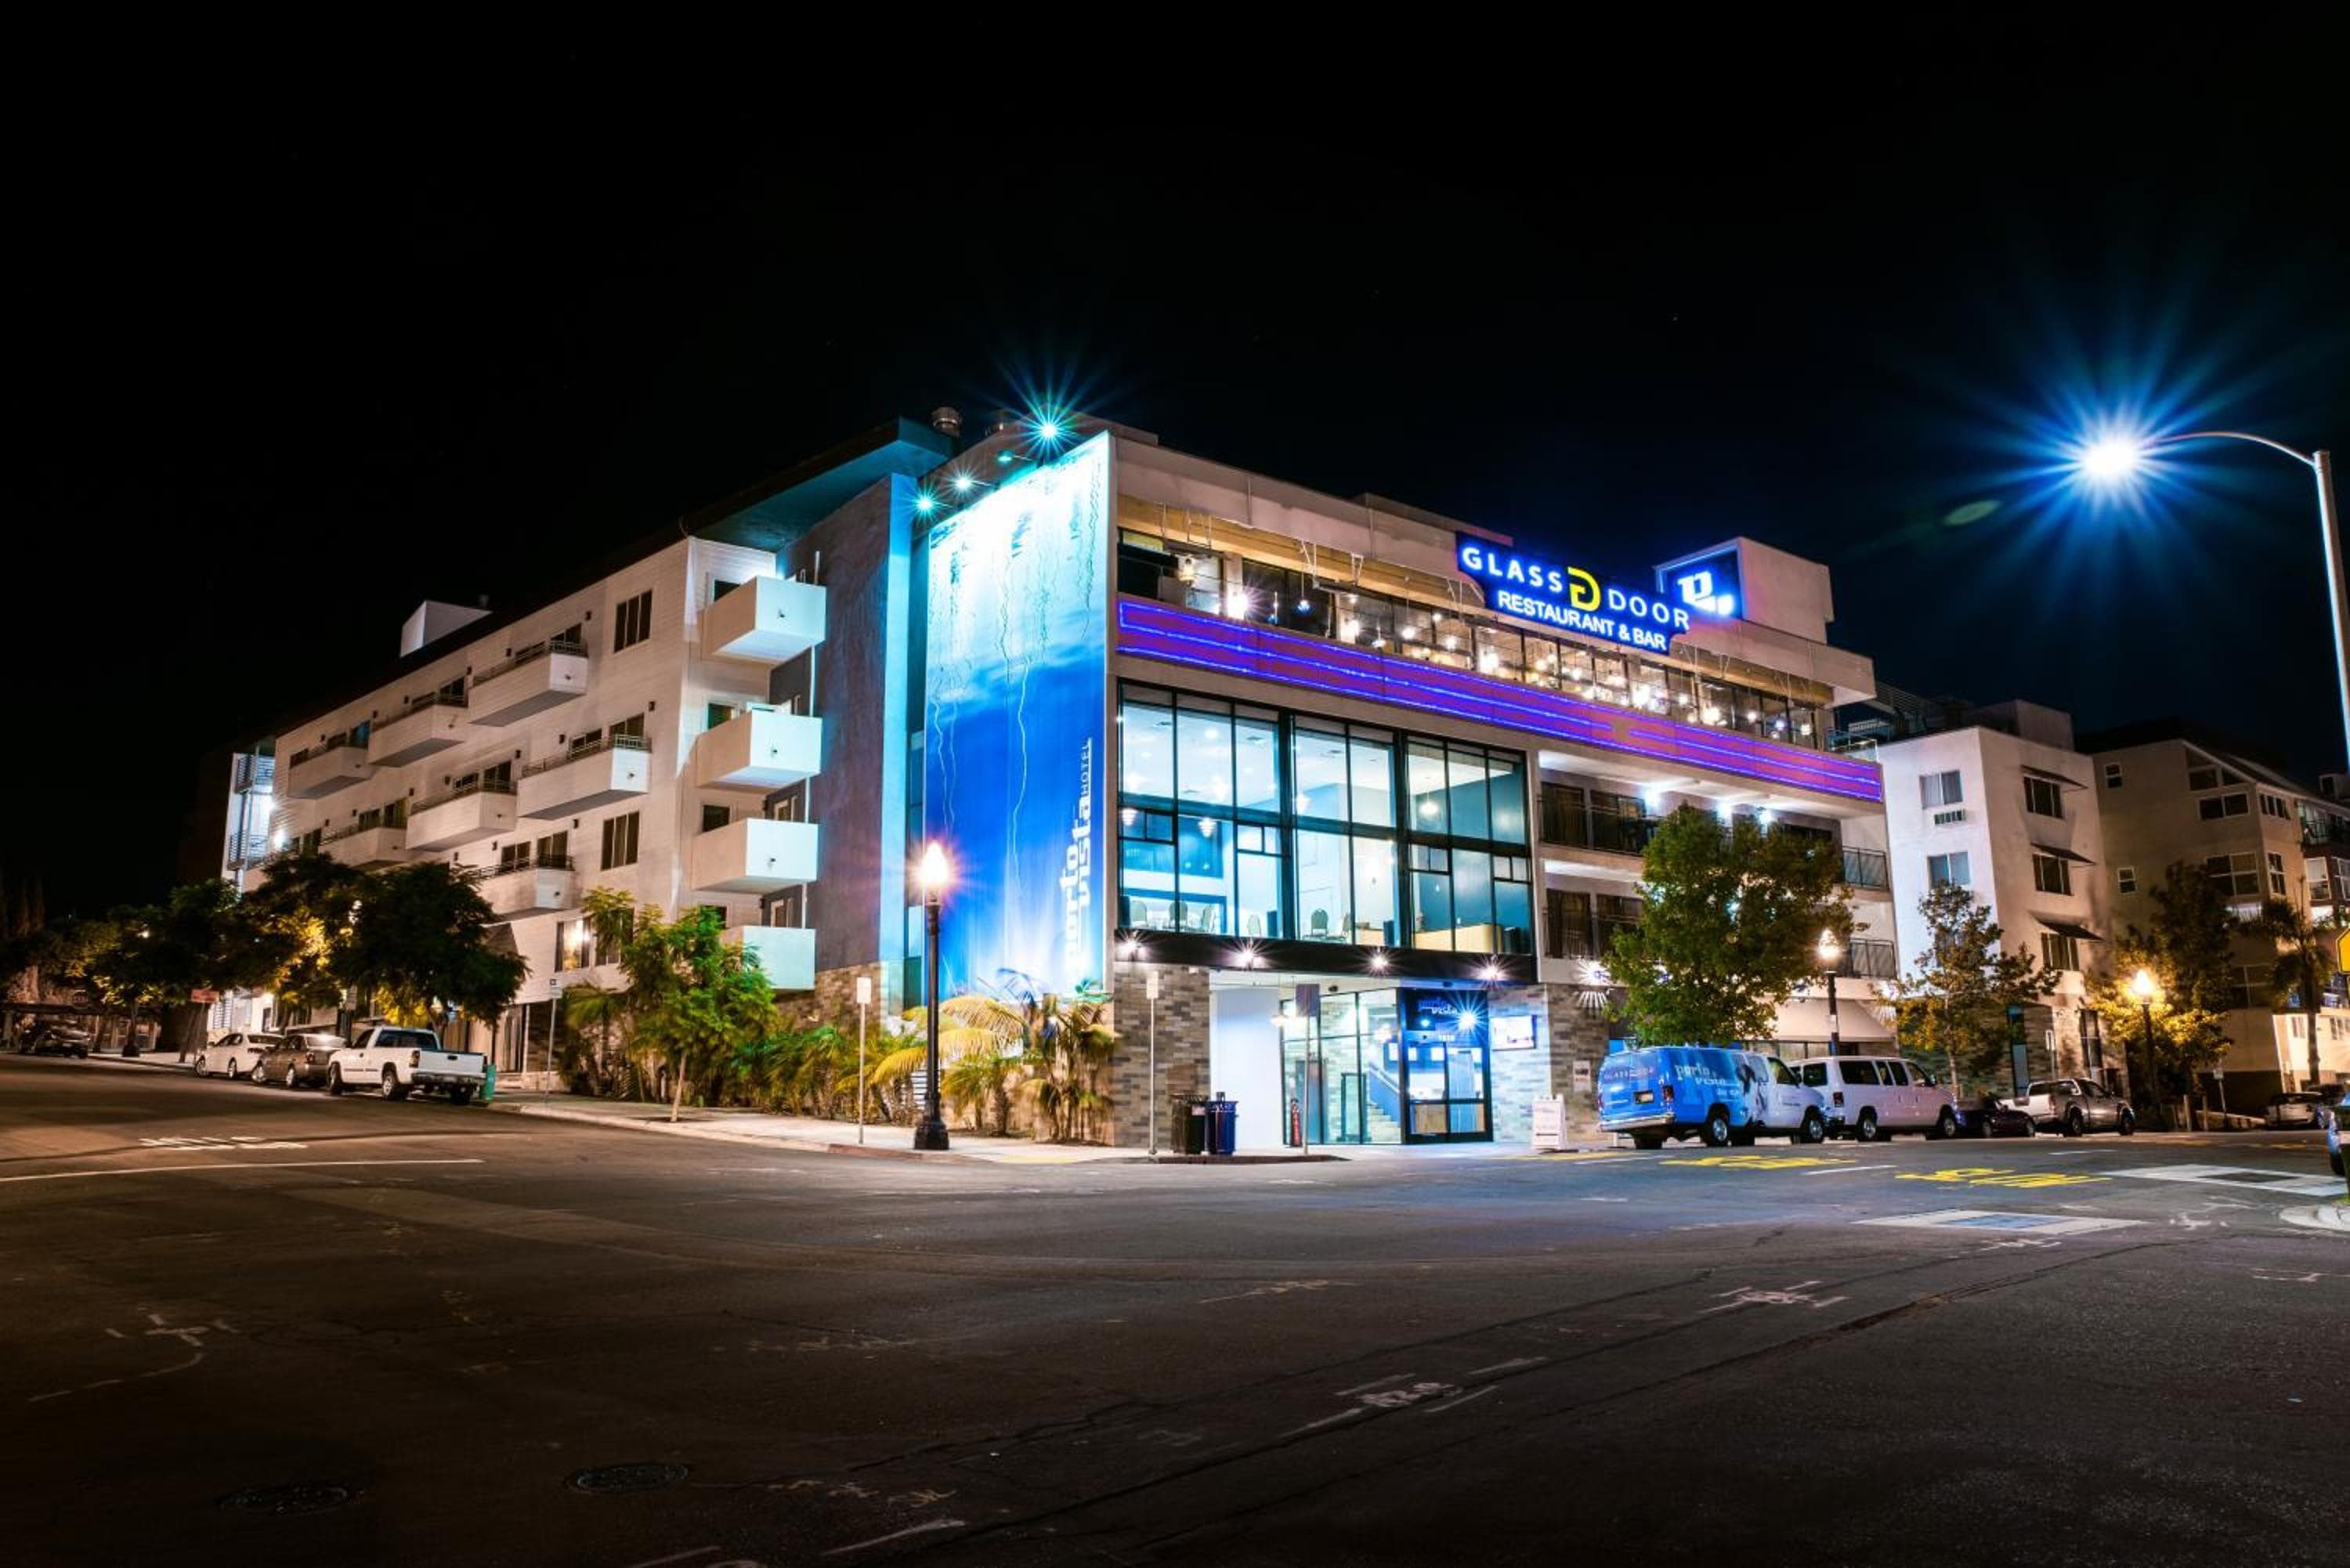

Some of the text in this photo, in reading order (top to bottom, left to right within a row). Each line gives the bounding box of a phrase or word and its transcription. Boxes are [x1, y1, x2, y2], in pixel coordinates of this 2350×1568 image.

[1462, 547, 1564, 593] GLASS
[1608, 588, 1690, 630] DOOR
[1499, 591, 1667, 650] RESTAURANT & BAR
[1072, 743, 1090, 908] vista HOTEL
